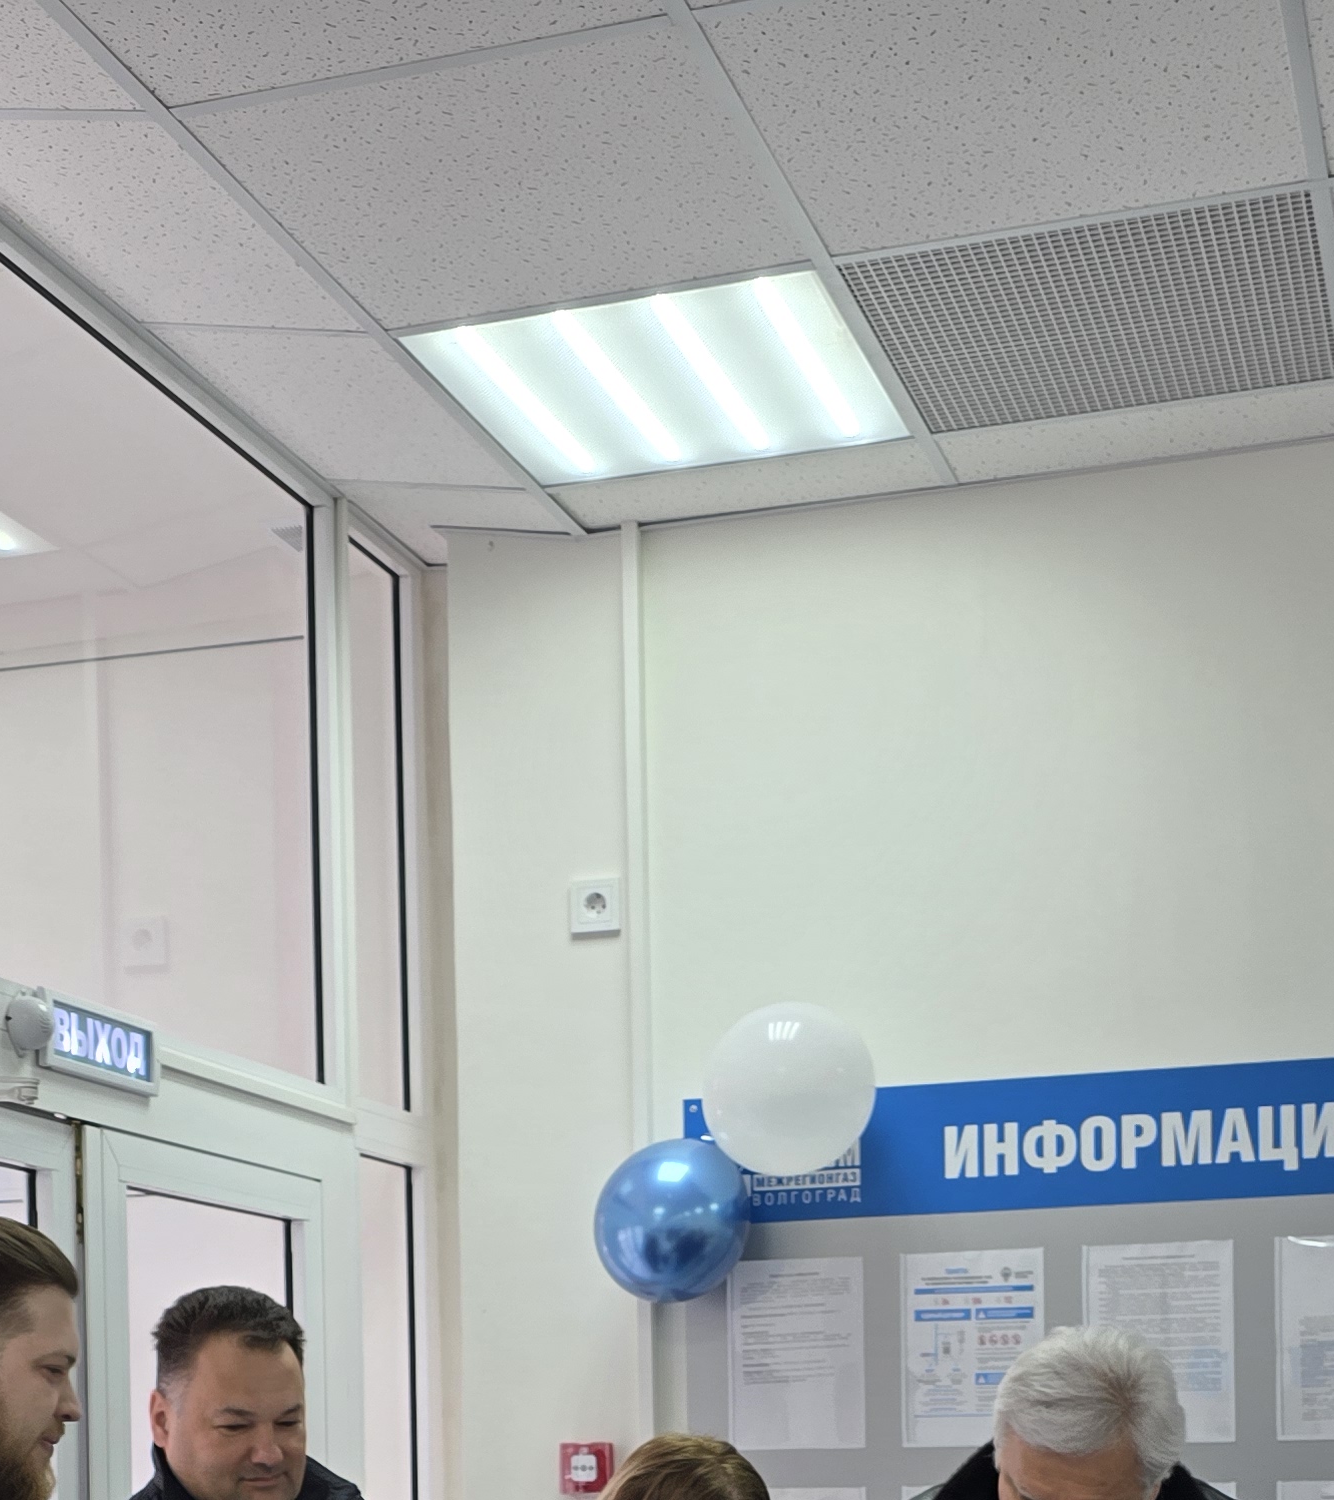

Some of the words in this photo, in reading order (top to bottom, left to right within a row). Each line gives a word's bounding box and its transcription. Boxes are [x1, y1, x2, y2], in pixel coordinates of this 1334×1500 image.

[53, 1007, 146, 1076] ВЫХОД
[755, 1171, 857, 1188] МЕЖРЕГИОНГАЗ
[752, 1187, 862, 1206] ВОЛГОГРАД
